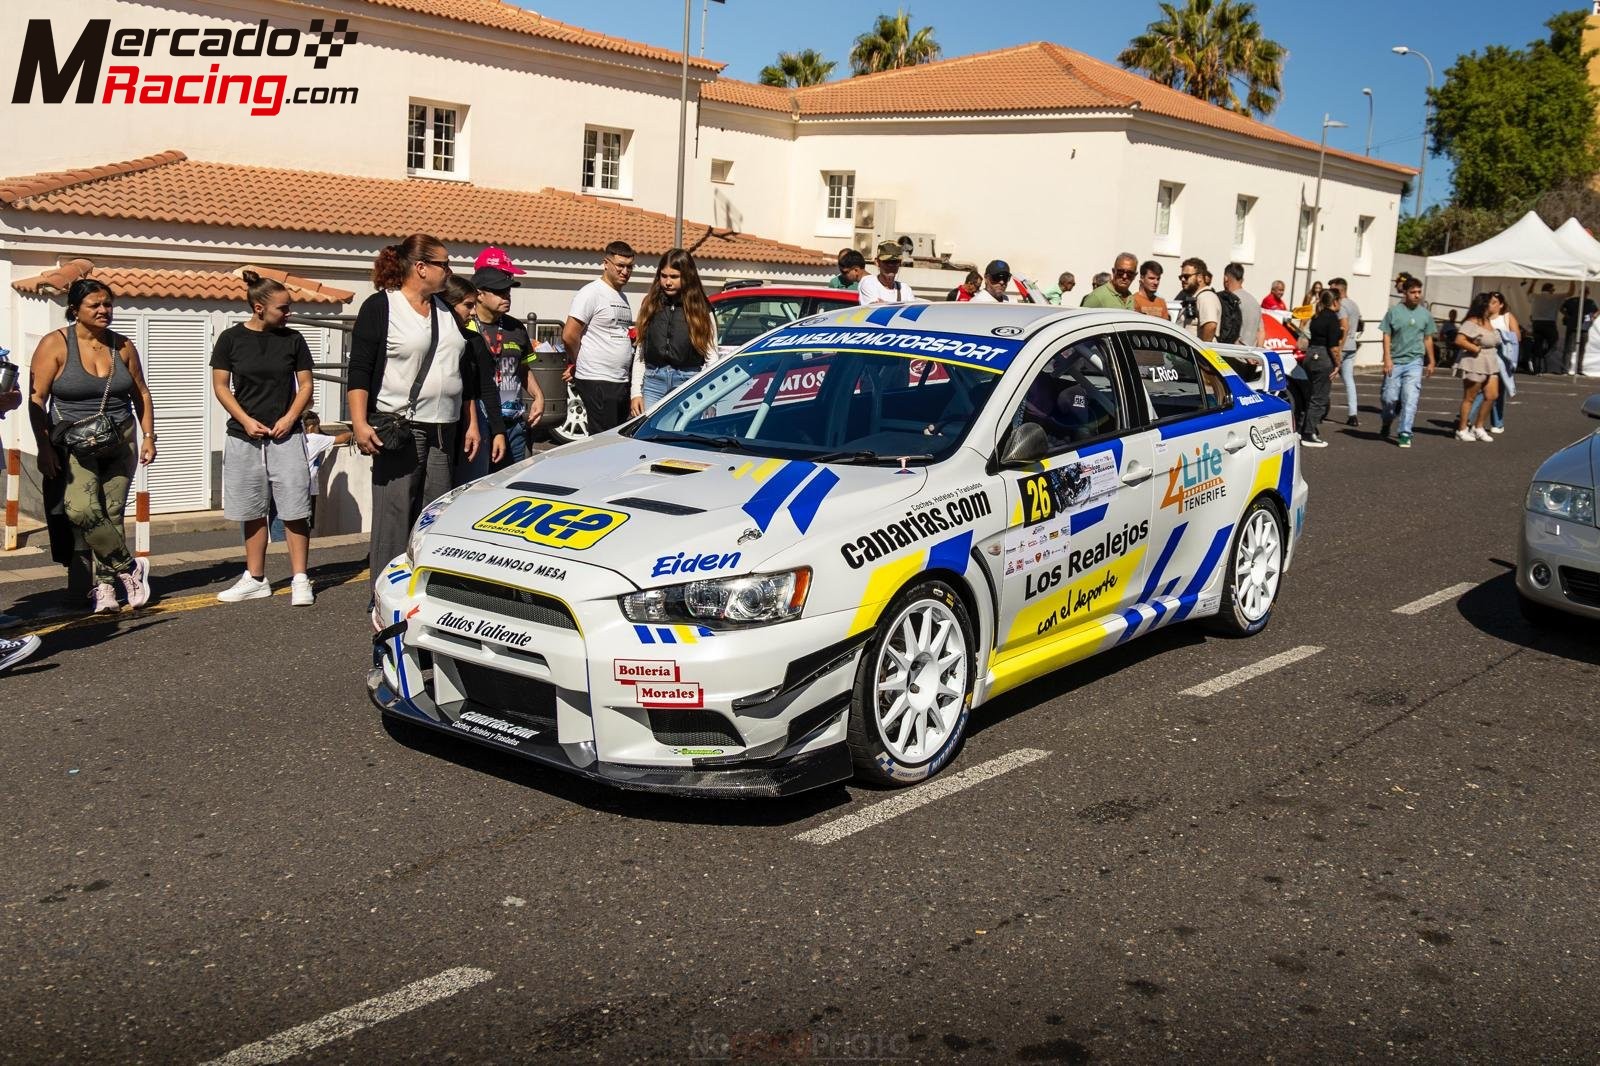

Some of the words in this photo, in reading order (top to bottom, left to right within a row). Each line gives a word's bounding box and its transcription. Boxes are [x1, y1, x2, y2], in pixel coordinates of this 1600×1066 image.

[760, 332, 1008, 362] TEAMSAINZMOTORSPORT
[958, 482, 983, 494] Traslados
[1027, 477, 1051, 522] 26
[1184, 485, 1226, 511] TENERIFE
[485, 501, 613, 540] MEP
[840, 490, 992, 569] canarias.com
[441, 546, 487, 561] SERVICIO
[485, 555, 534, 572] MANOLO
[534, 565, 567, 581] MESA
[651, 552, 741, 577] Eiden
[1025, 564, 1062, 600] Los
[1068, 519, 1149, 578] Realejos
[1037, 610, 1058, 635] con
[1060, 589, 1072, 619] el
[1073, 569, 1118, 611] deporte
[436, 612, 475, 632] Autos
[474, 620, 531, 646] Valiente
[642, 688, 694, 698] Morales
